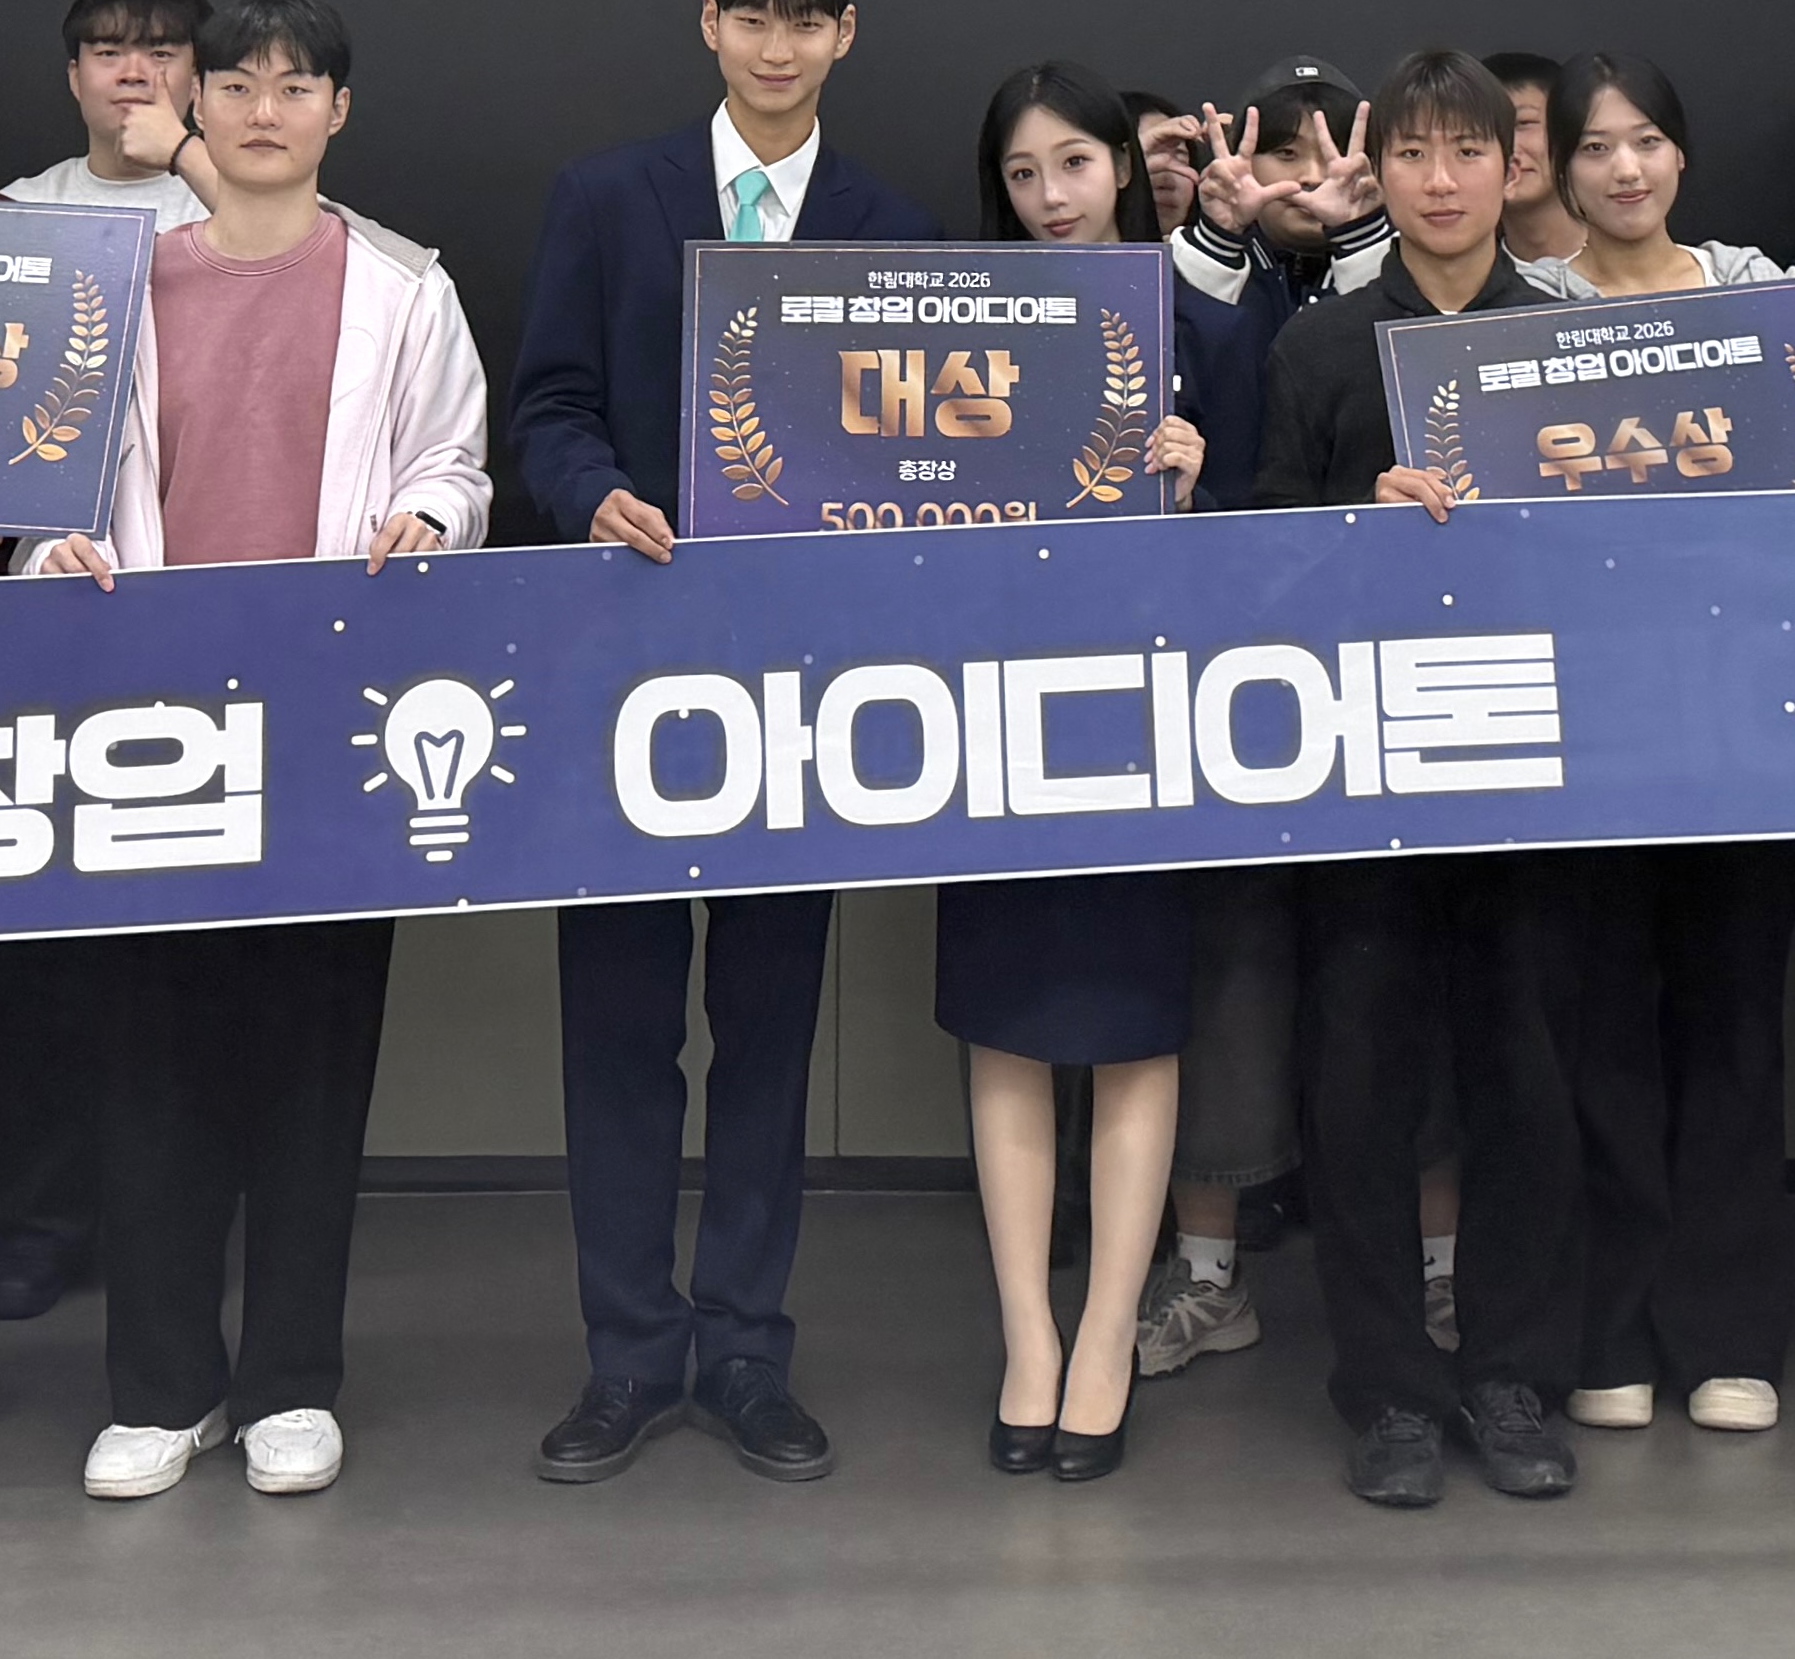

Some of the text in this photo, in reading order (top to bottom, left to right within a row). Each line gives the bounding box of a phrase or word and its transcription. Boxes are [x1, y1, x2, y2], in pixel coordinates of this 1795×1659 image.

[868, 272, 991, 289] 한림대학교 2026
[782, 296, 1077, 324] 로컬 창업 아이디어톤
[1556, 322, 1675, 348] 한림대학교 2026
[1478, 336, 1762, 392] 로컬 창업 아이디어톤
[839, 349, 1020, 437] 대상
[1536, 407, 1733, 491] 우수상
[898, 460, 956, 481] 총장상
[614, 633, 1563, 838] 아이디어톤
